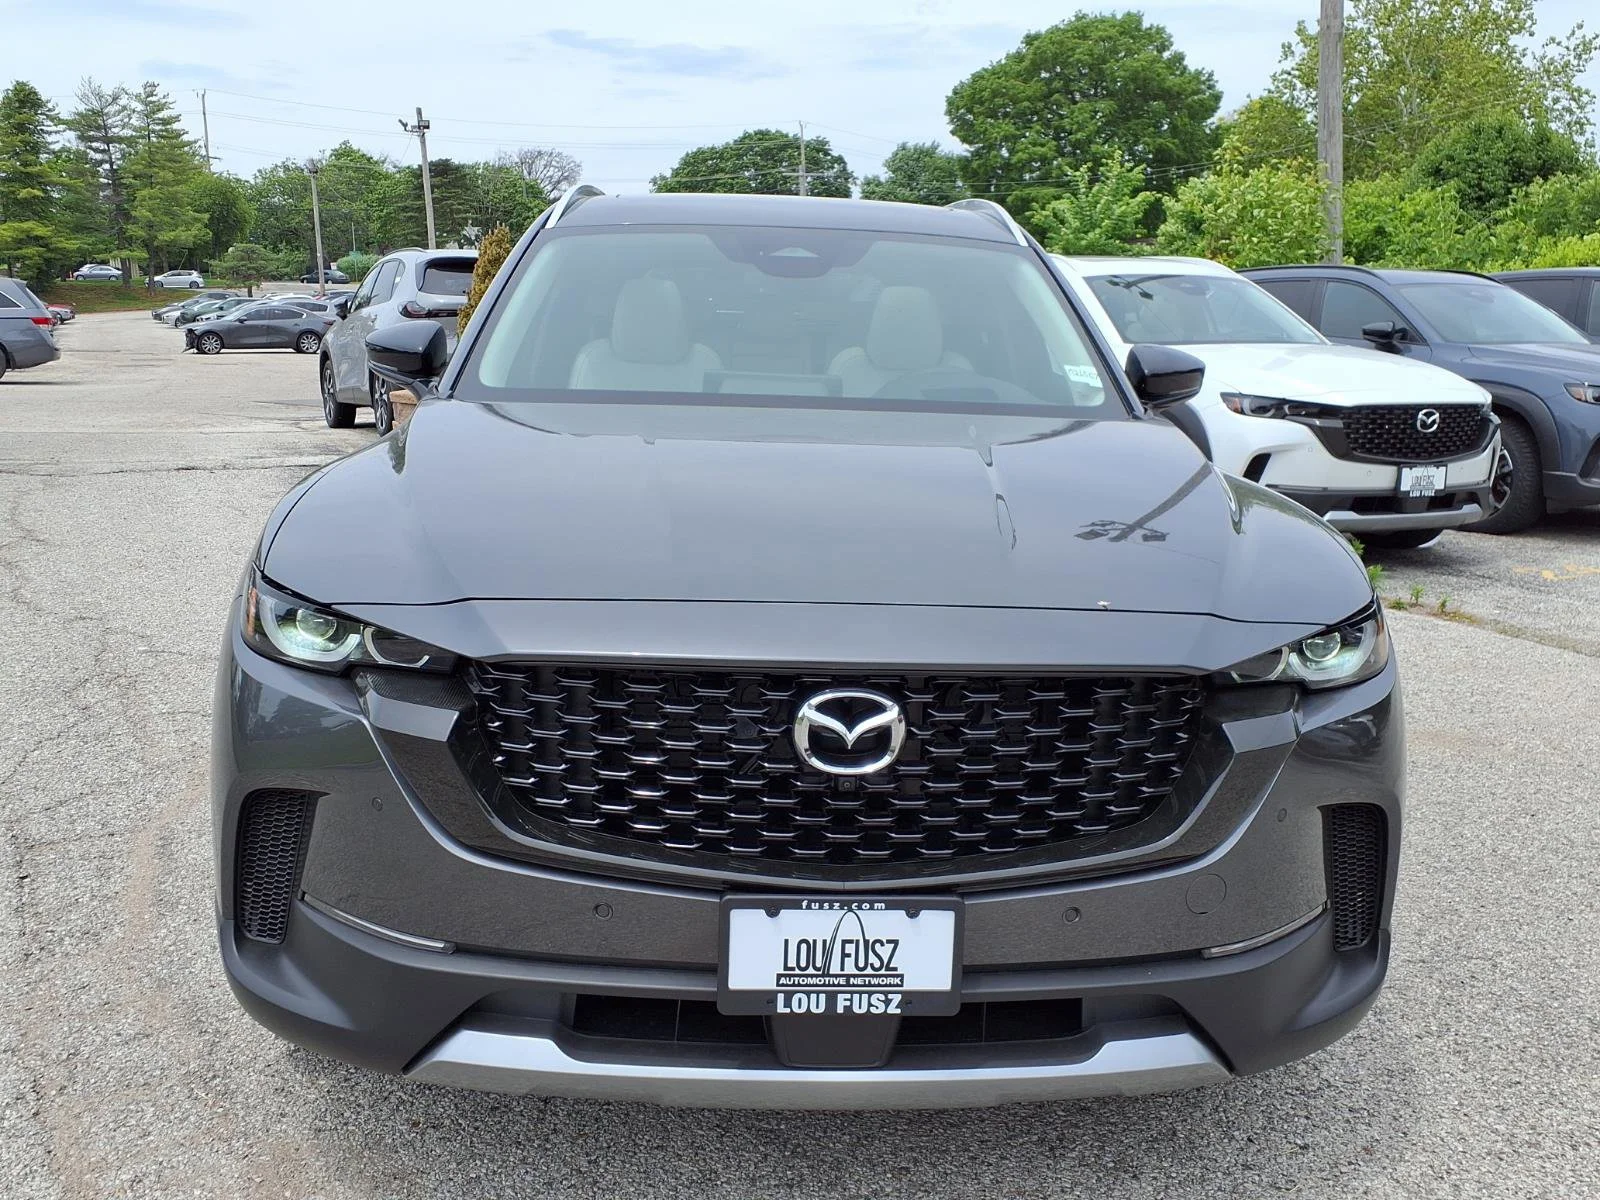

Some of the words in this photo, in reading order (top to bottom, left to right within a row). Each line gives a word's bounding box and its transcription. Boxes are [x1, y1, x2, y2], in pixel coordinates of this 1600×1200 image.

[801, 900, 886, 910] fusz.com
[783, 938, 828, 972] LOU
[840, 938, 900, 972] FUSZ
[779, 977, 847, 985] AUTOMOTIVE
[850, 977, 902, 985] NETWORK
[776, 992, 826, 1014] LOU
[836, 993, 902, 1014] FUSZ
